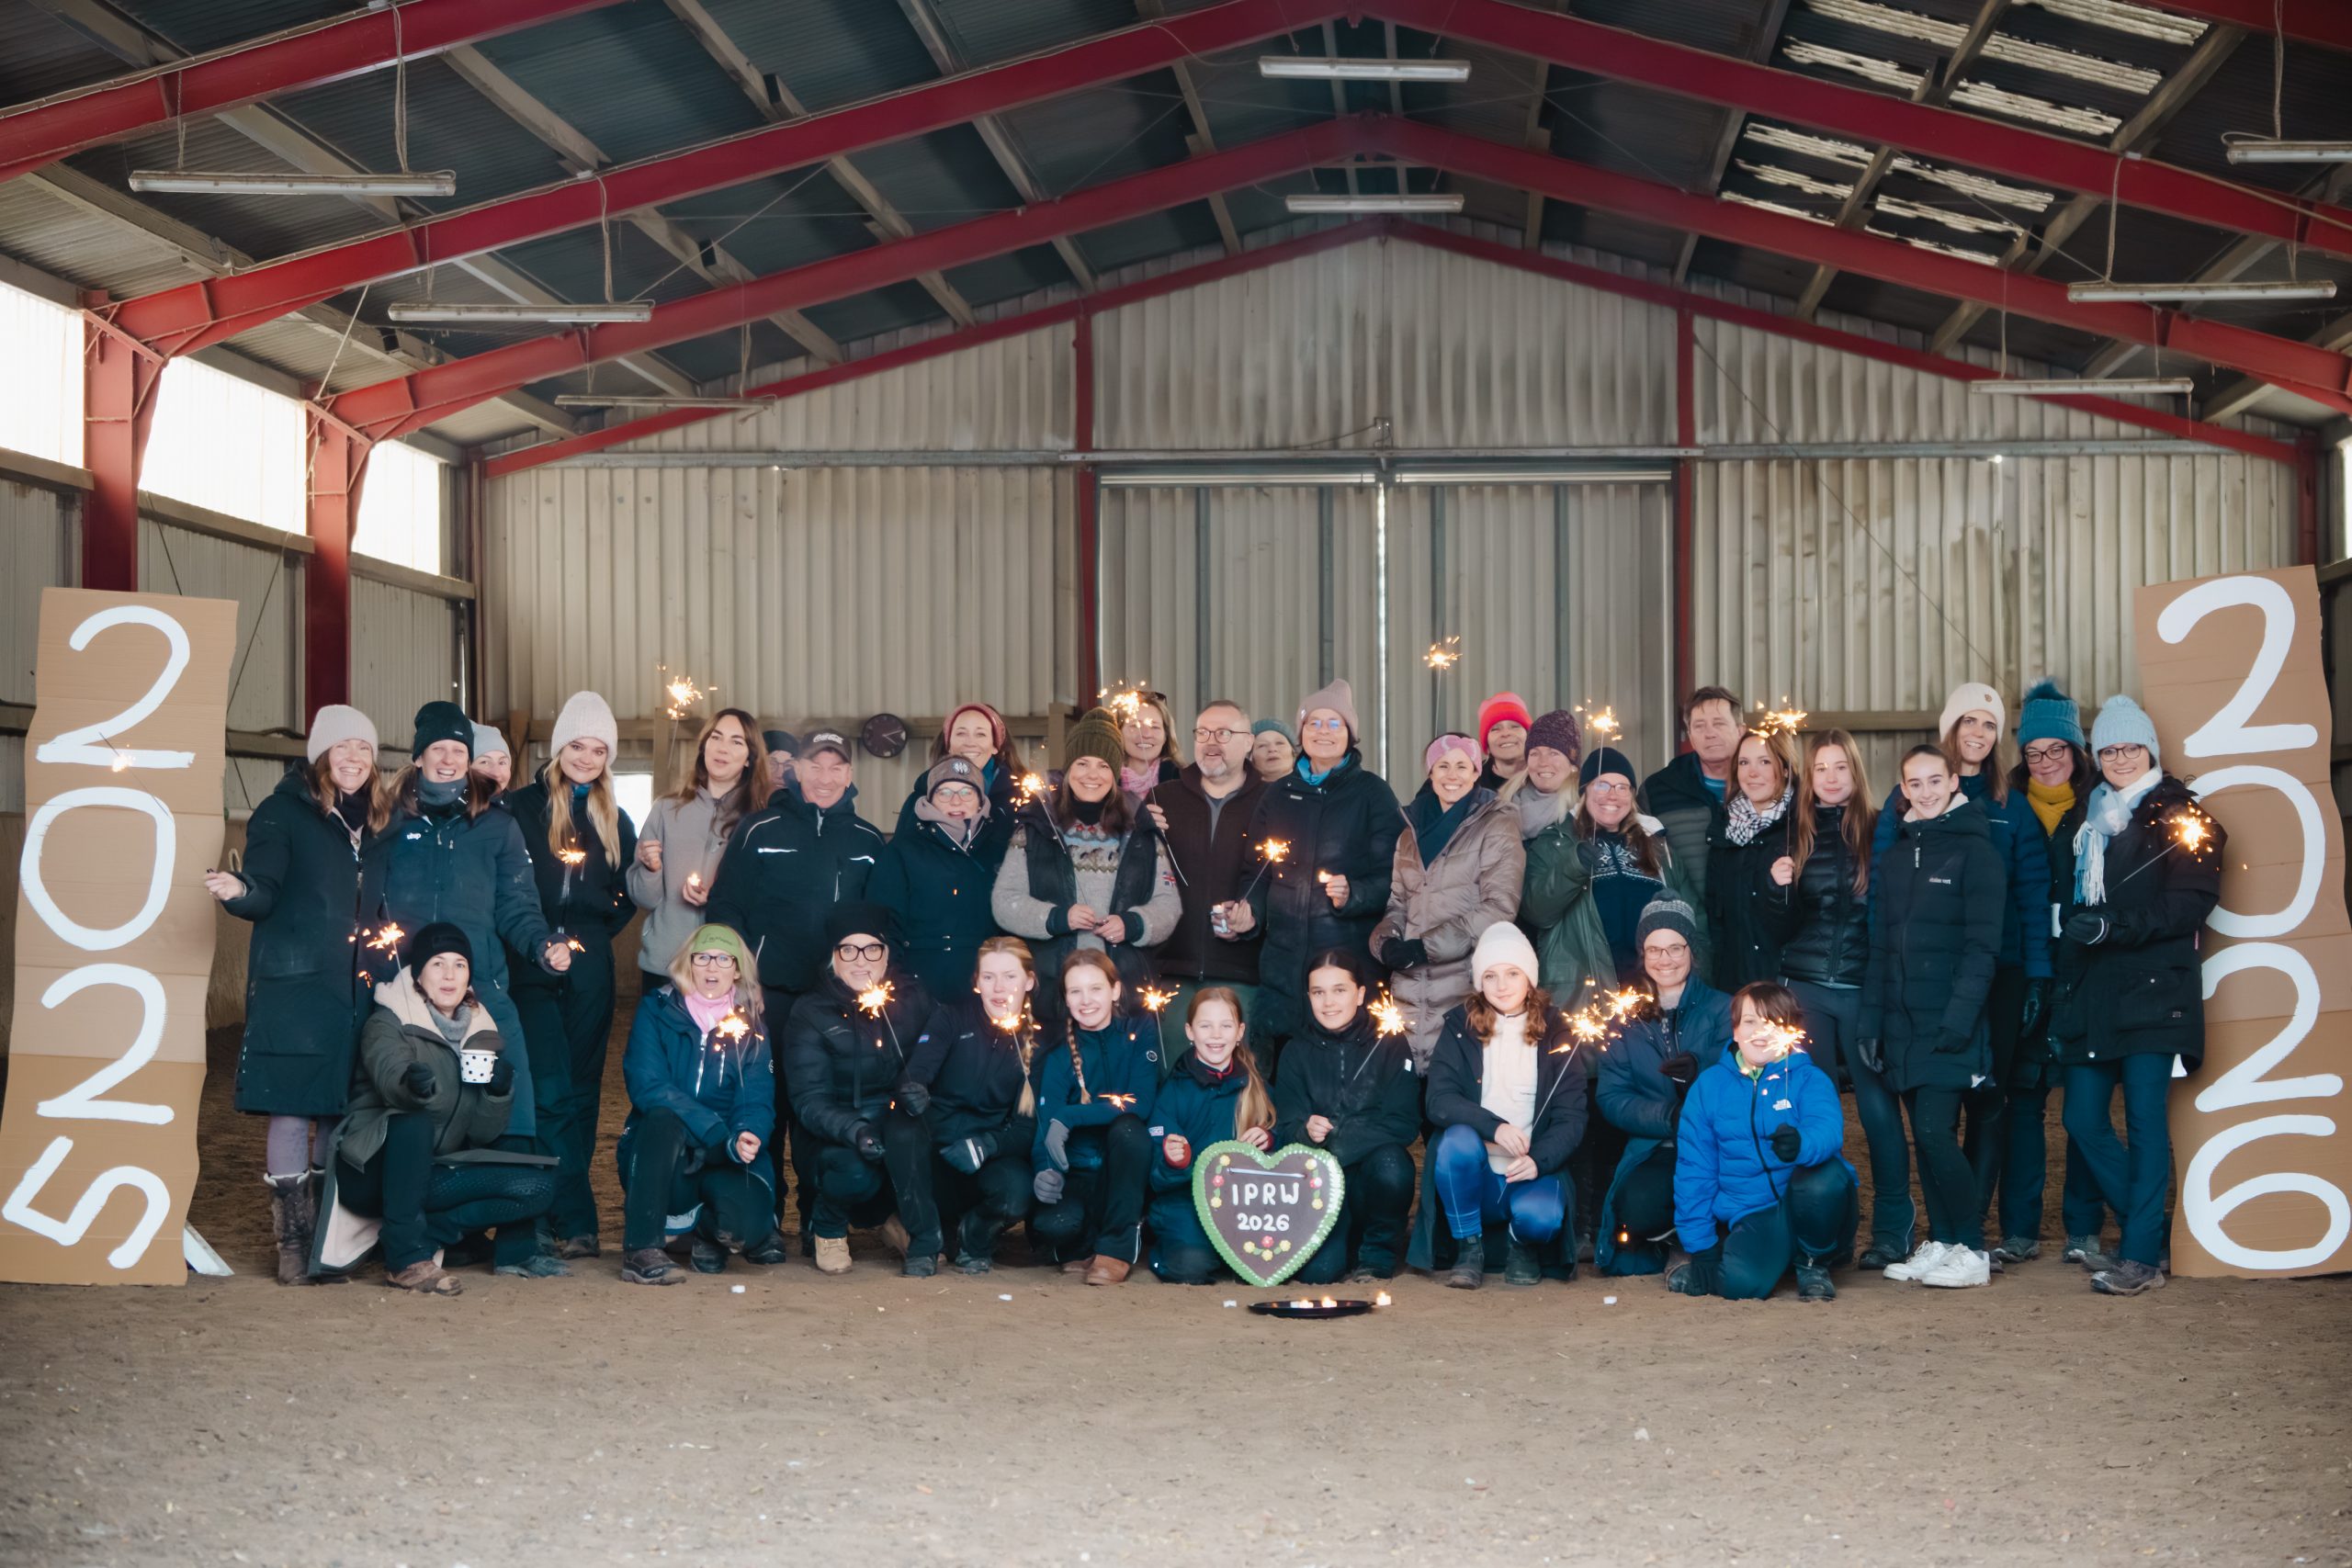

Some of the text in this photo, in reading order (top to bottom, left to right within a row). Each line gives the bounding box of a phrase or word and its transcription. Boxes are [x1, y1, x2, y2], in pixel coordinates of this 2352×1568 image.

[2, 604, 196, 1270] 2025
[2156, 575, 2351, 1270] 2026
[1232, 1182, 1300, 1206] IPRW
[1237, 1213, 1290, 1232] 2026
